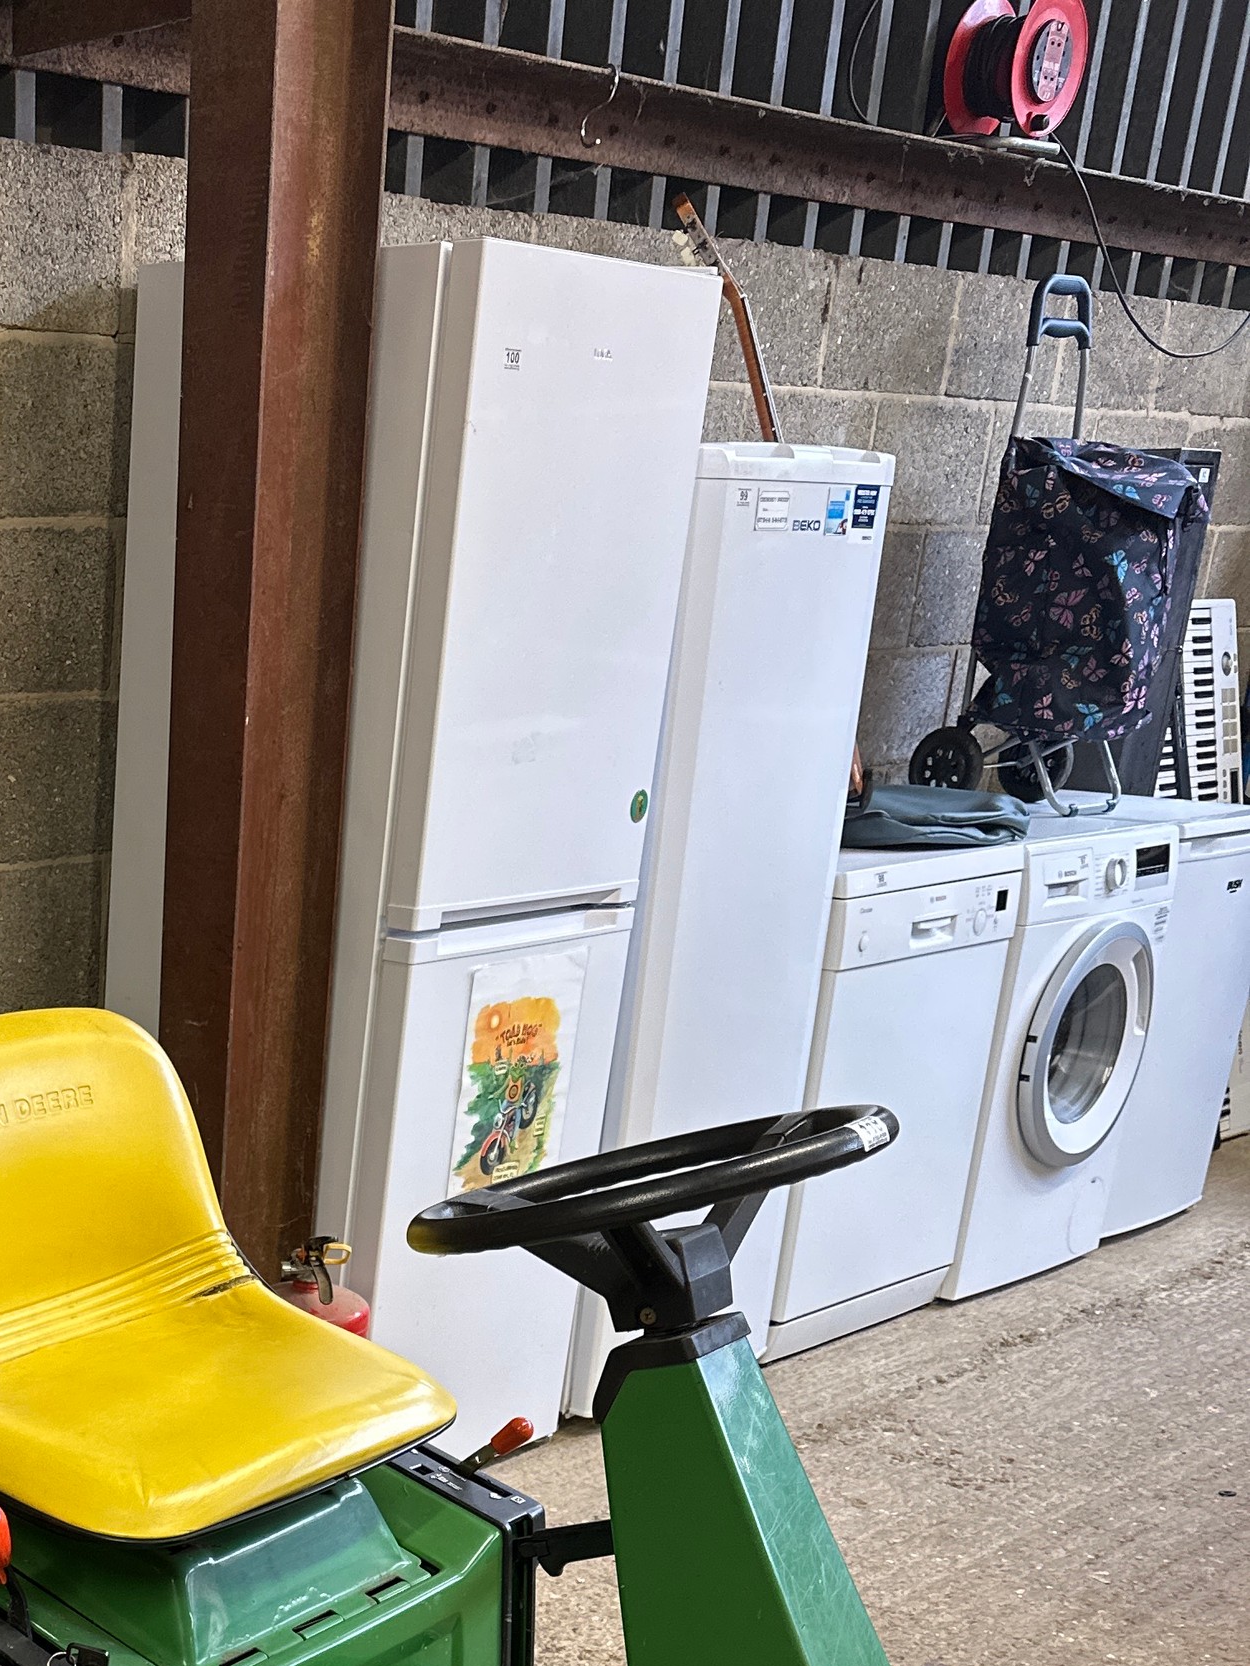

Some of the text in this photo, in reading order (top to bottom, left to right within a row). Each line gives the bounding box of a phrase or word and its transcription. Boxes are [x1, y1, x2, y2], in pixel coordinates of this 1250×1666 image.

[506, 352, 520, 364] 100
[792, 519, 821, 532] BEKO
[1226, 878, 1244, 891] BUSH
[14, 1085, 94, 1123] DEERE
